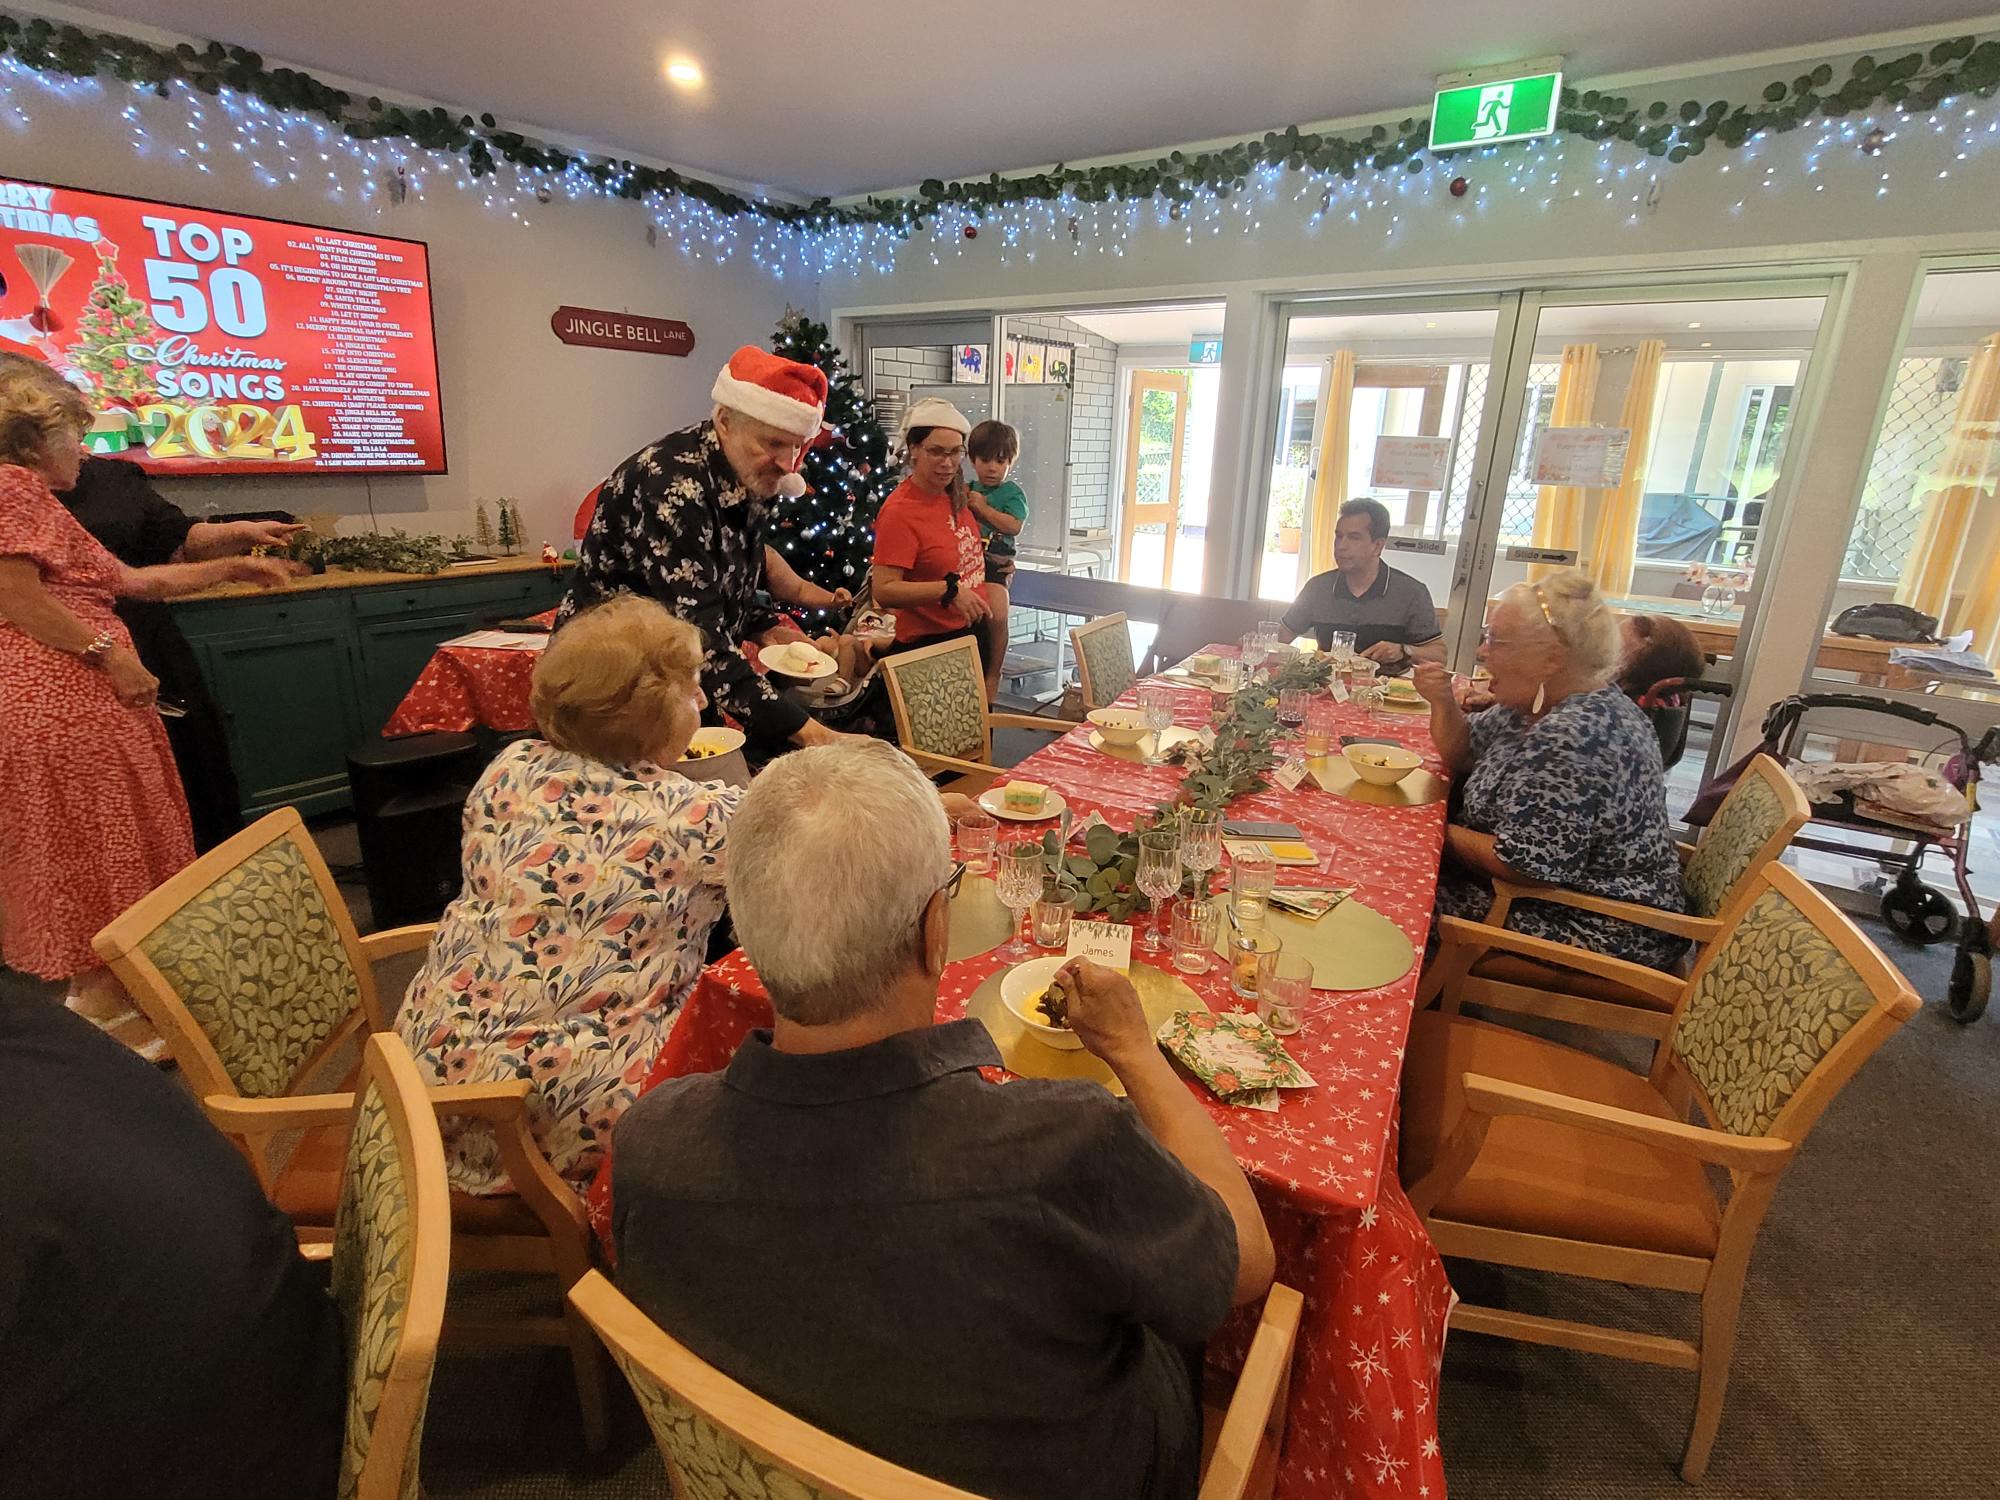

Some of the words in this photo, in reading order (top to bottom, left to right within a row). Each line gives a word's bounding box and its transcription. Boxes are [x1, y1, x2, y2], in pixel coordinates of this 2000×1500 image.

[142, 216, 253, 266] TOP
[326, 238, 342, 246] LAST
[343, 240, 377, 251] CHRISTMAS
[299, 242, 312, 250] ALL
[315, 244, 336, 253] WANT
[336, 247, 349, 255] FOR
[350, 249, 384, 259] CHRISTMAS
[391, 254, 403, 262] YOU
[331, 255, 348, 263] FELIZ
[349, 257, 376, 266] NAVIDAD
[341, 264, 357, 272] HOLY
[358, 266, 377, 274] NIGHT
[294, 266, 330, 277] BEGINNING
[341, 272, 358, 280] LOOK
[364, 274, 376, 282] LOT
[391, 277, 423, 287] CHRISTMAS
[322, 278, 348, 287] AROUND
[363, 282, 396, 292] CHRISTMAS
[396, 286, 412, 294] TREE
[144, 258, 267, 337] 50
[336, 287, 358, 295] SILENT
[359, 290, 378, 298] NIGHT
[335, 295, 355, 303] SANTA
[355, 297, 371, 305] TELL
[330, 302, 352, 310] WHITE
[352, 304, 387, 314] CHRISTMAS
[319, 317, 340, 325] HAPPY
[366, 328, 385, 336] HAPPY
[565, 318, 623, 338] JINGLE
[627, 325, 662, 343] BELL
[663, 330, 687, 341] LANE
[354, 335, 387, 344] CHRISTMAS
[346, 342, 366, 350] JINGLE
[127, 335, 287, 370] Christmas
[363, 351, 396, 359] CHRISTMAS
[347, 365, 381, 373] CHRISTMAS
[155, 370, 285, 400] SONGS
[321, 386, 352, 394] YOURSELF
[137, 404, 317, 461] 2024
[1417, 541, 1440, 551] Slide
[1514, 549, 1539, 559] Slide
[1082, 944, 1114, 957] James
